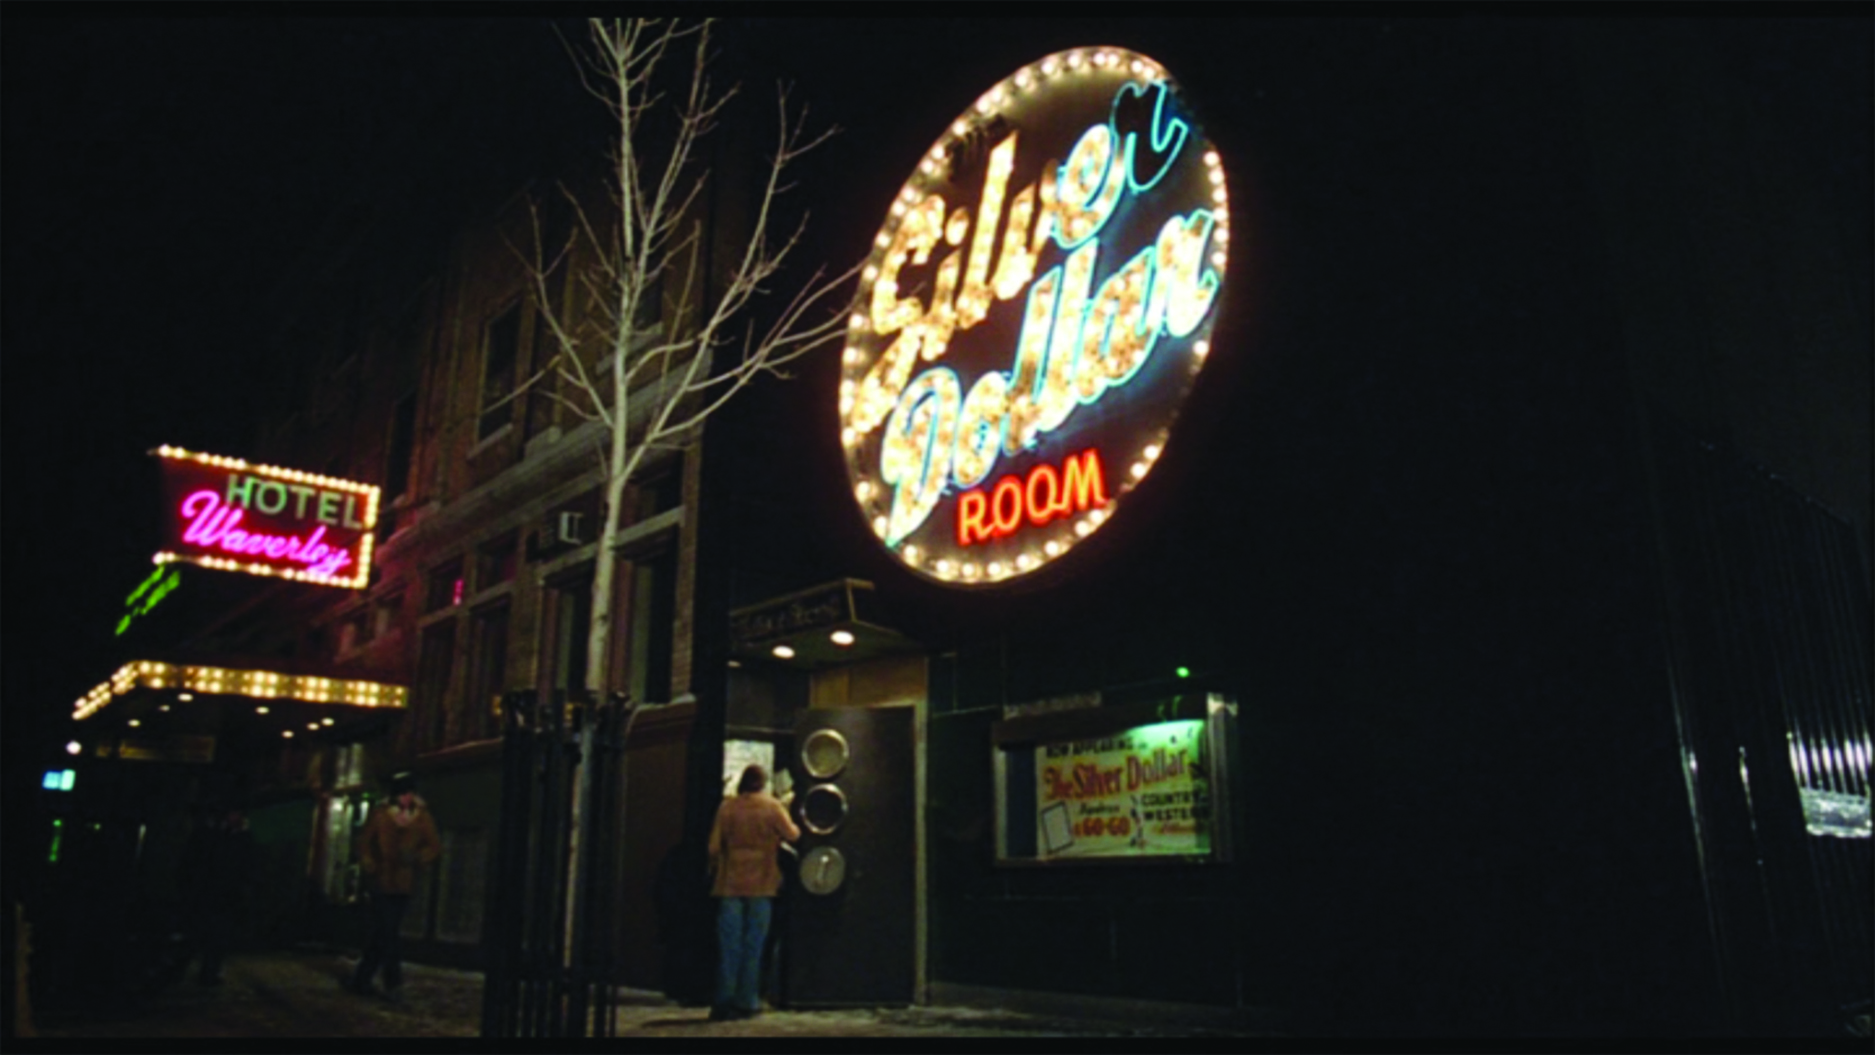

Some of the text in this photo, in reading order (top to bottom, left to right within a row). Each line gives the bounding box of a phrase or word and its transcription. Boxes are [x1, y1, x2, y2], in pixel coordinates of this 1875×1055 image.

[850, 81, 1187, 434] Silver
[882, 208, 1217, 546] Dollar
[227, 475, 362, 529] HOTEL
[959, 450, 1105, 544] ROOM
[182, 490, 351, 577] Waverley
[1045, 746, 1188, 801] The Silver Dollar
[1141, 790, 1201, 806] COUNTRY
[1083, 816, 1131, 836] GO-GO
